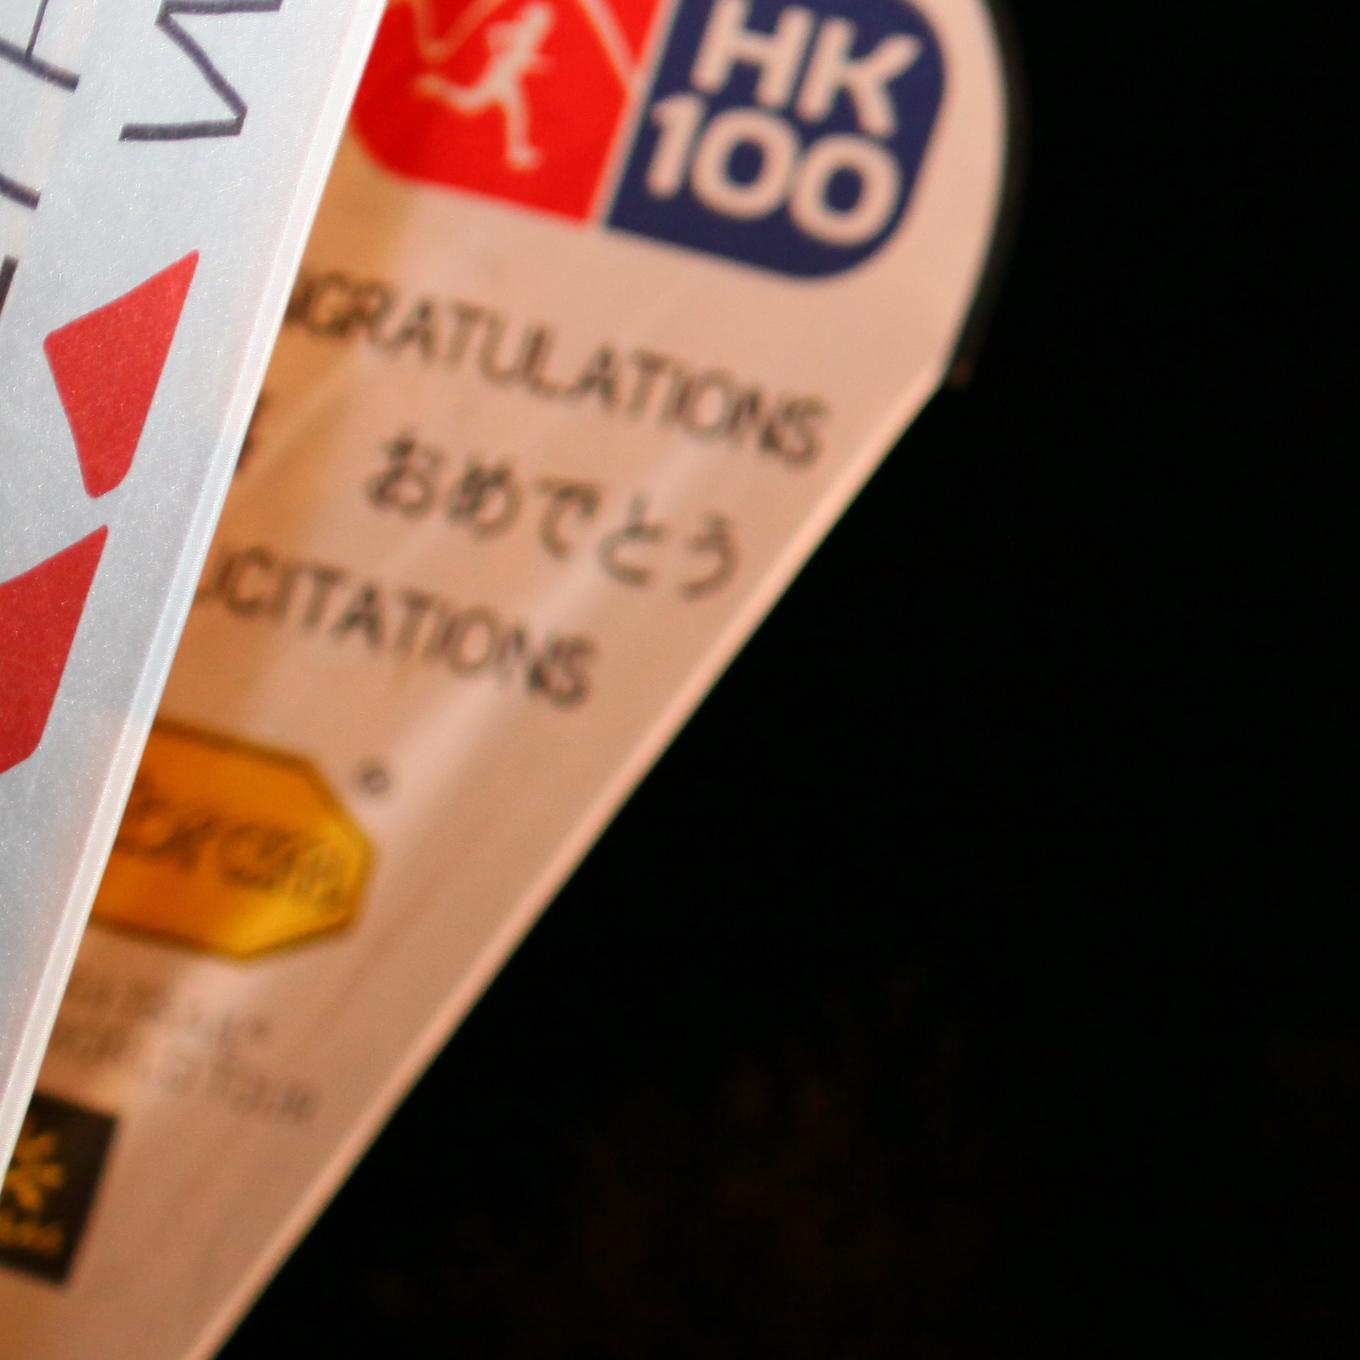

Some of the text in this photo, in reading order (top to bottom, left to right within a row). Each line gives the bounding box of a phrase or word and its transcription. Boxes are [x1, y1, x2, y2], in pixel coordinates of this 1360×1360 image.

[692, 0, 922, 137] HK
[646, 104, 904, 249] 100
[364, 422, 740, 602] おめでとう
